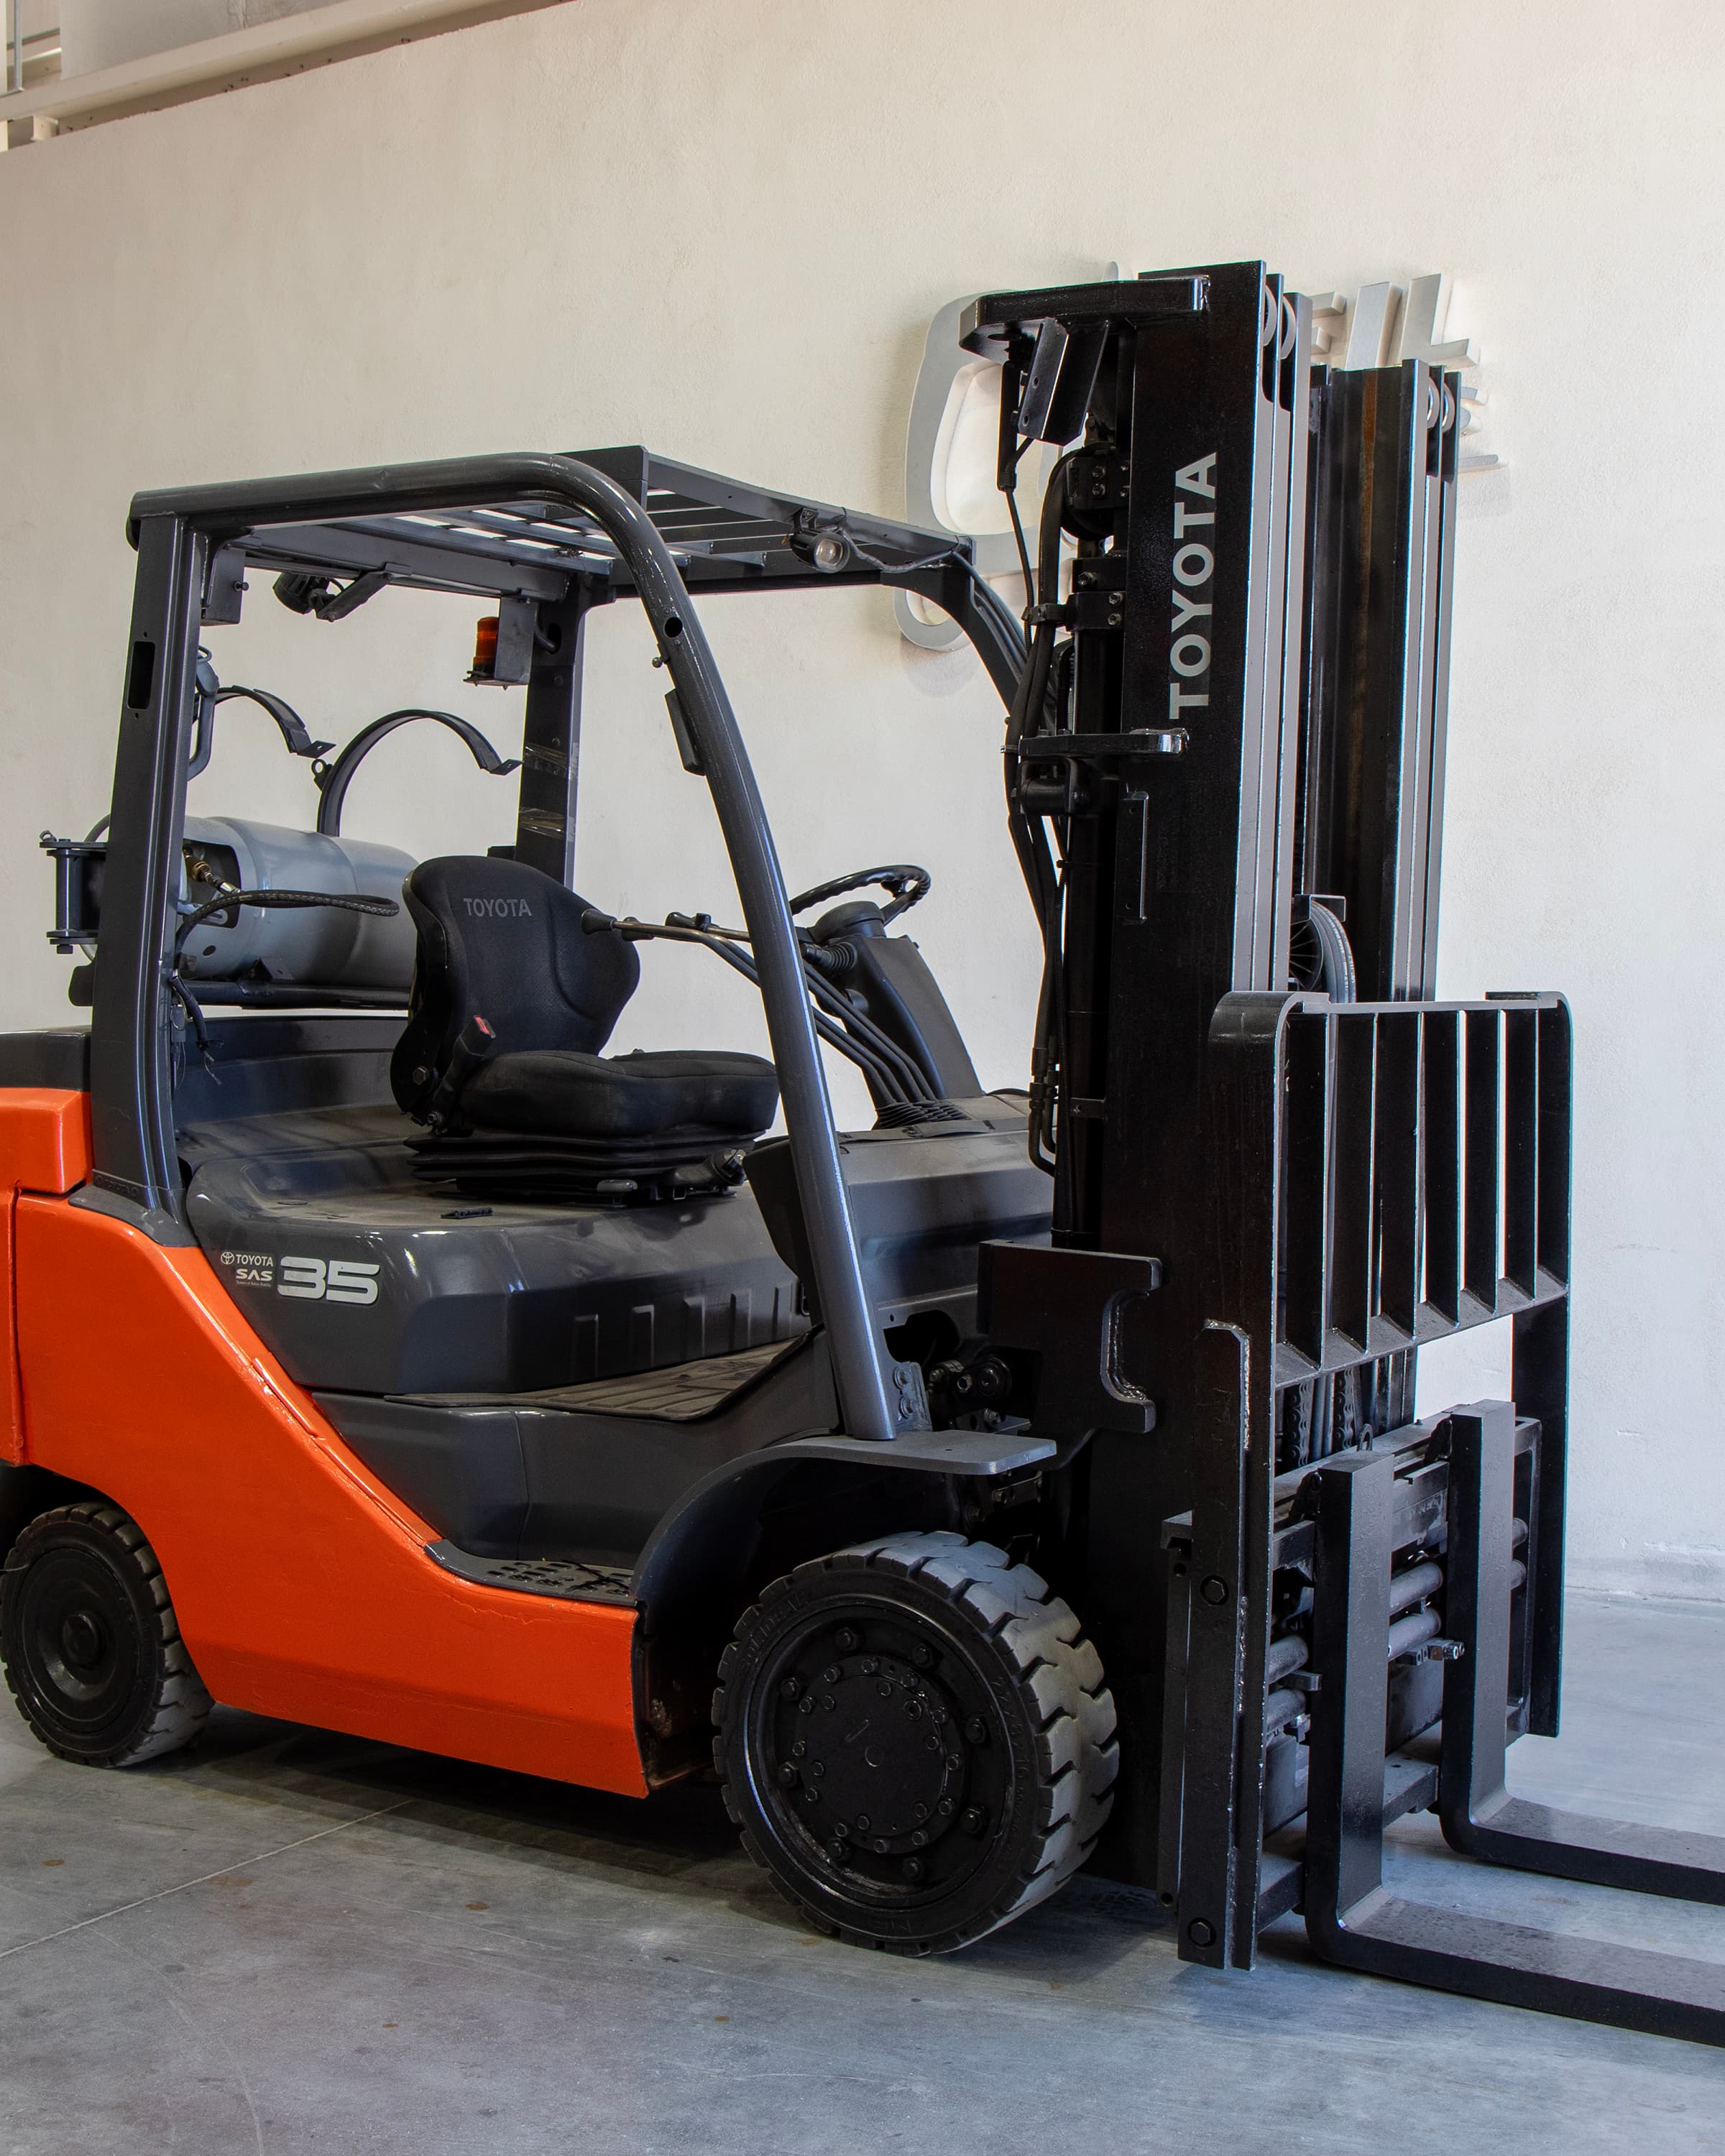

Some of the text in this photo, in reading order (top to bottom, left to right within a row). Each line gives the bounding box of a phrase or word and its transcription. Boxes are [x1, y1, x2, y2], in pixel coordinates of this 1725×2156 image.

[1169, 452, 1217, 719] TOYOTA
[464, 898, 532, 918] TOYOTA
[236, 1254, 273, 1266] TOYOTA
[236, 1268, 272, 1281] SAS
[277, 1256, 380, 1304] 35
